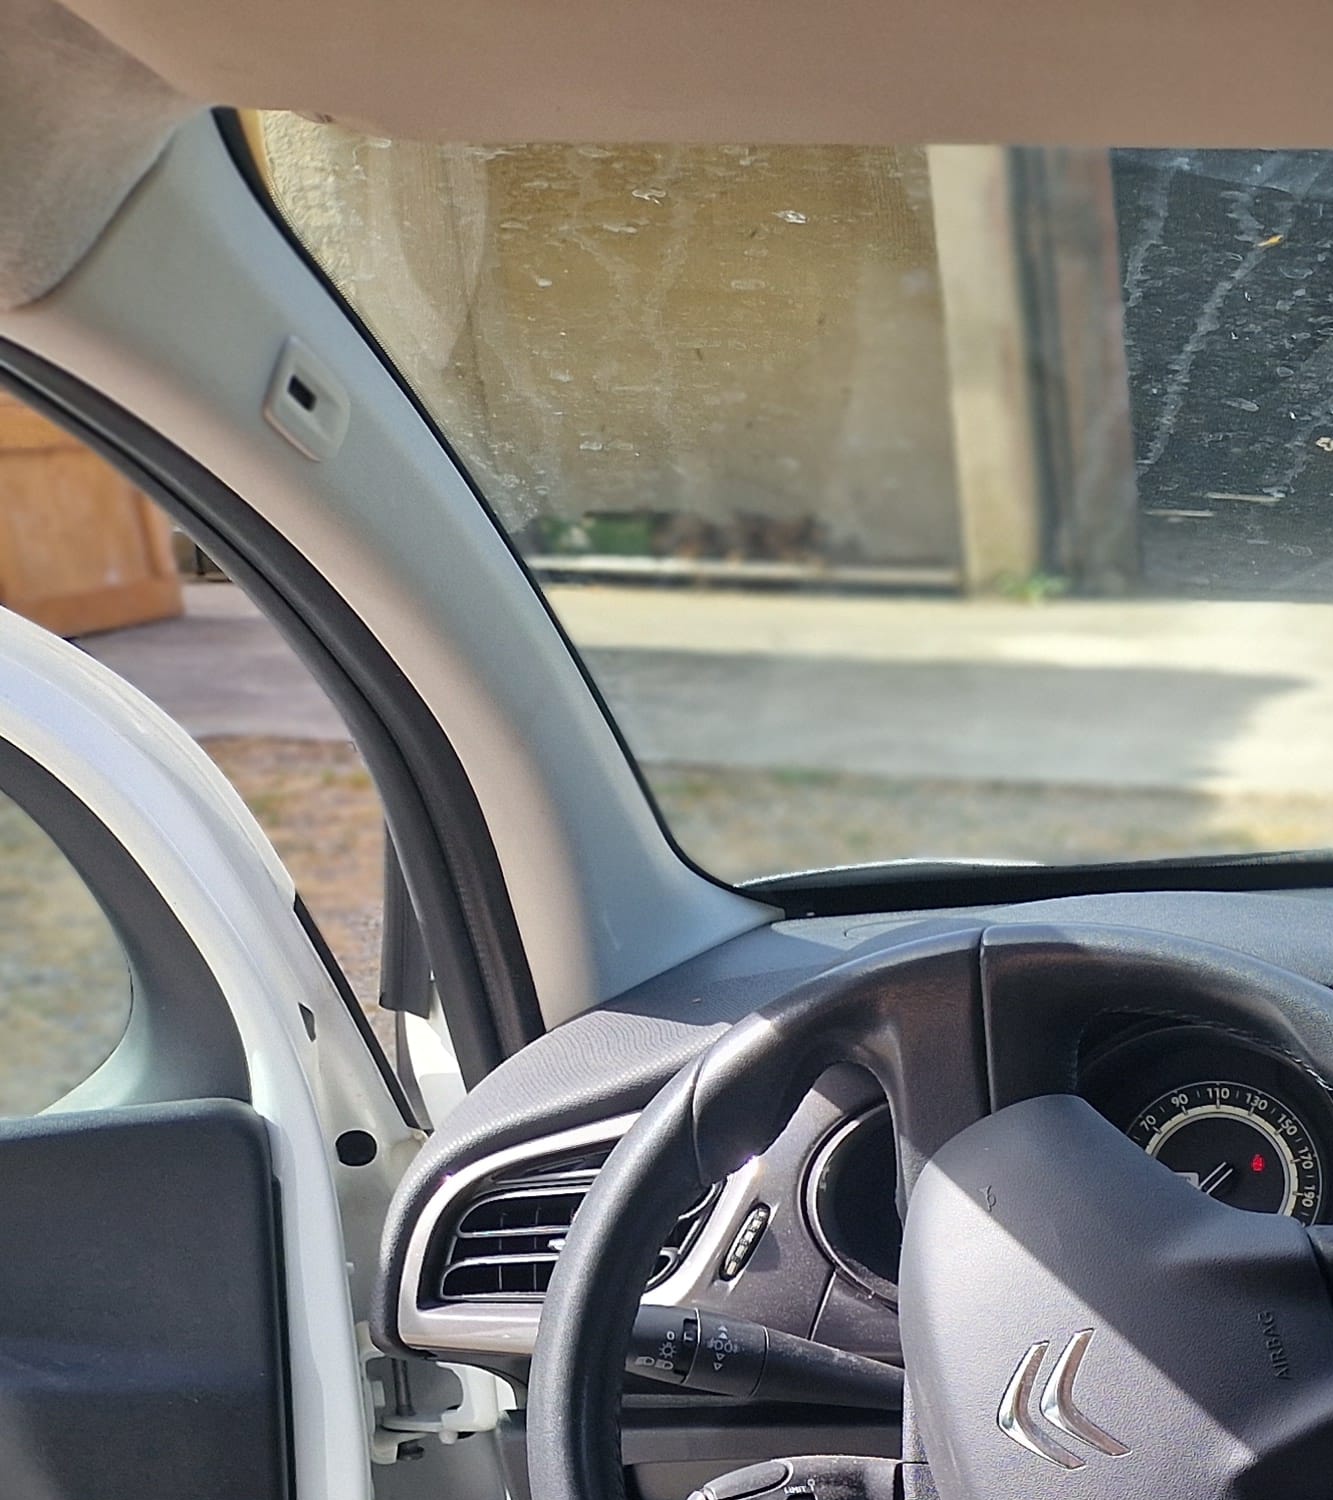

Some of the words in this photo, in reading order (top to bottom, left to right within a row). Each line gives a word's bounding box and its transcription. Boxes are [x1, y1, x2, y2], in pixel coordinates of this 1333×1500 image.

[1171, 1093, 1189, 1108] 90
[1206, 1087, 1230, 1099] 110
[1245, 1093, 1268, 1111] 130
[1139, 1115, 1157, 1131] 70
[1277, 1113, 1298, 1136] 150
[1298, 1146, 1314, 1170] 170
[1302, 1184, 1316, 1208] 190
[1257, 1311, 1293, 1380] AIRBAG
